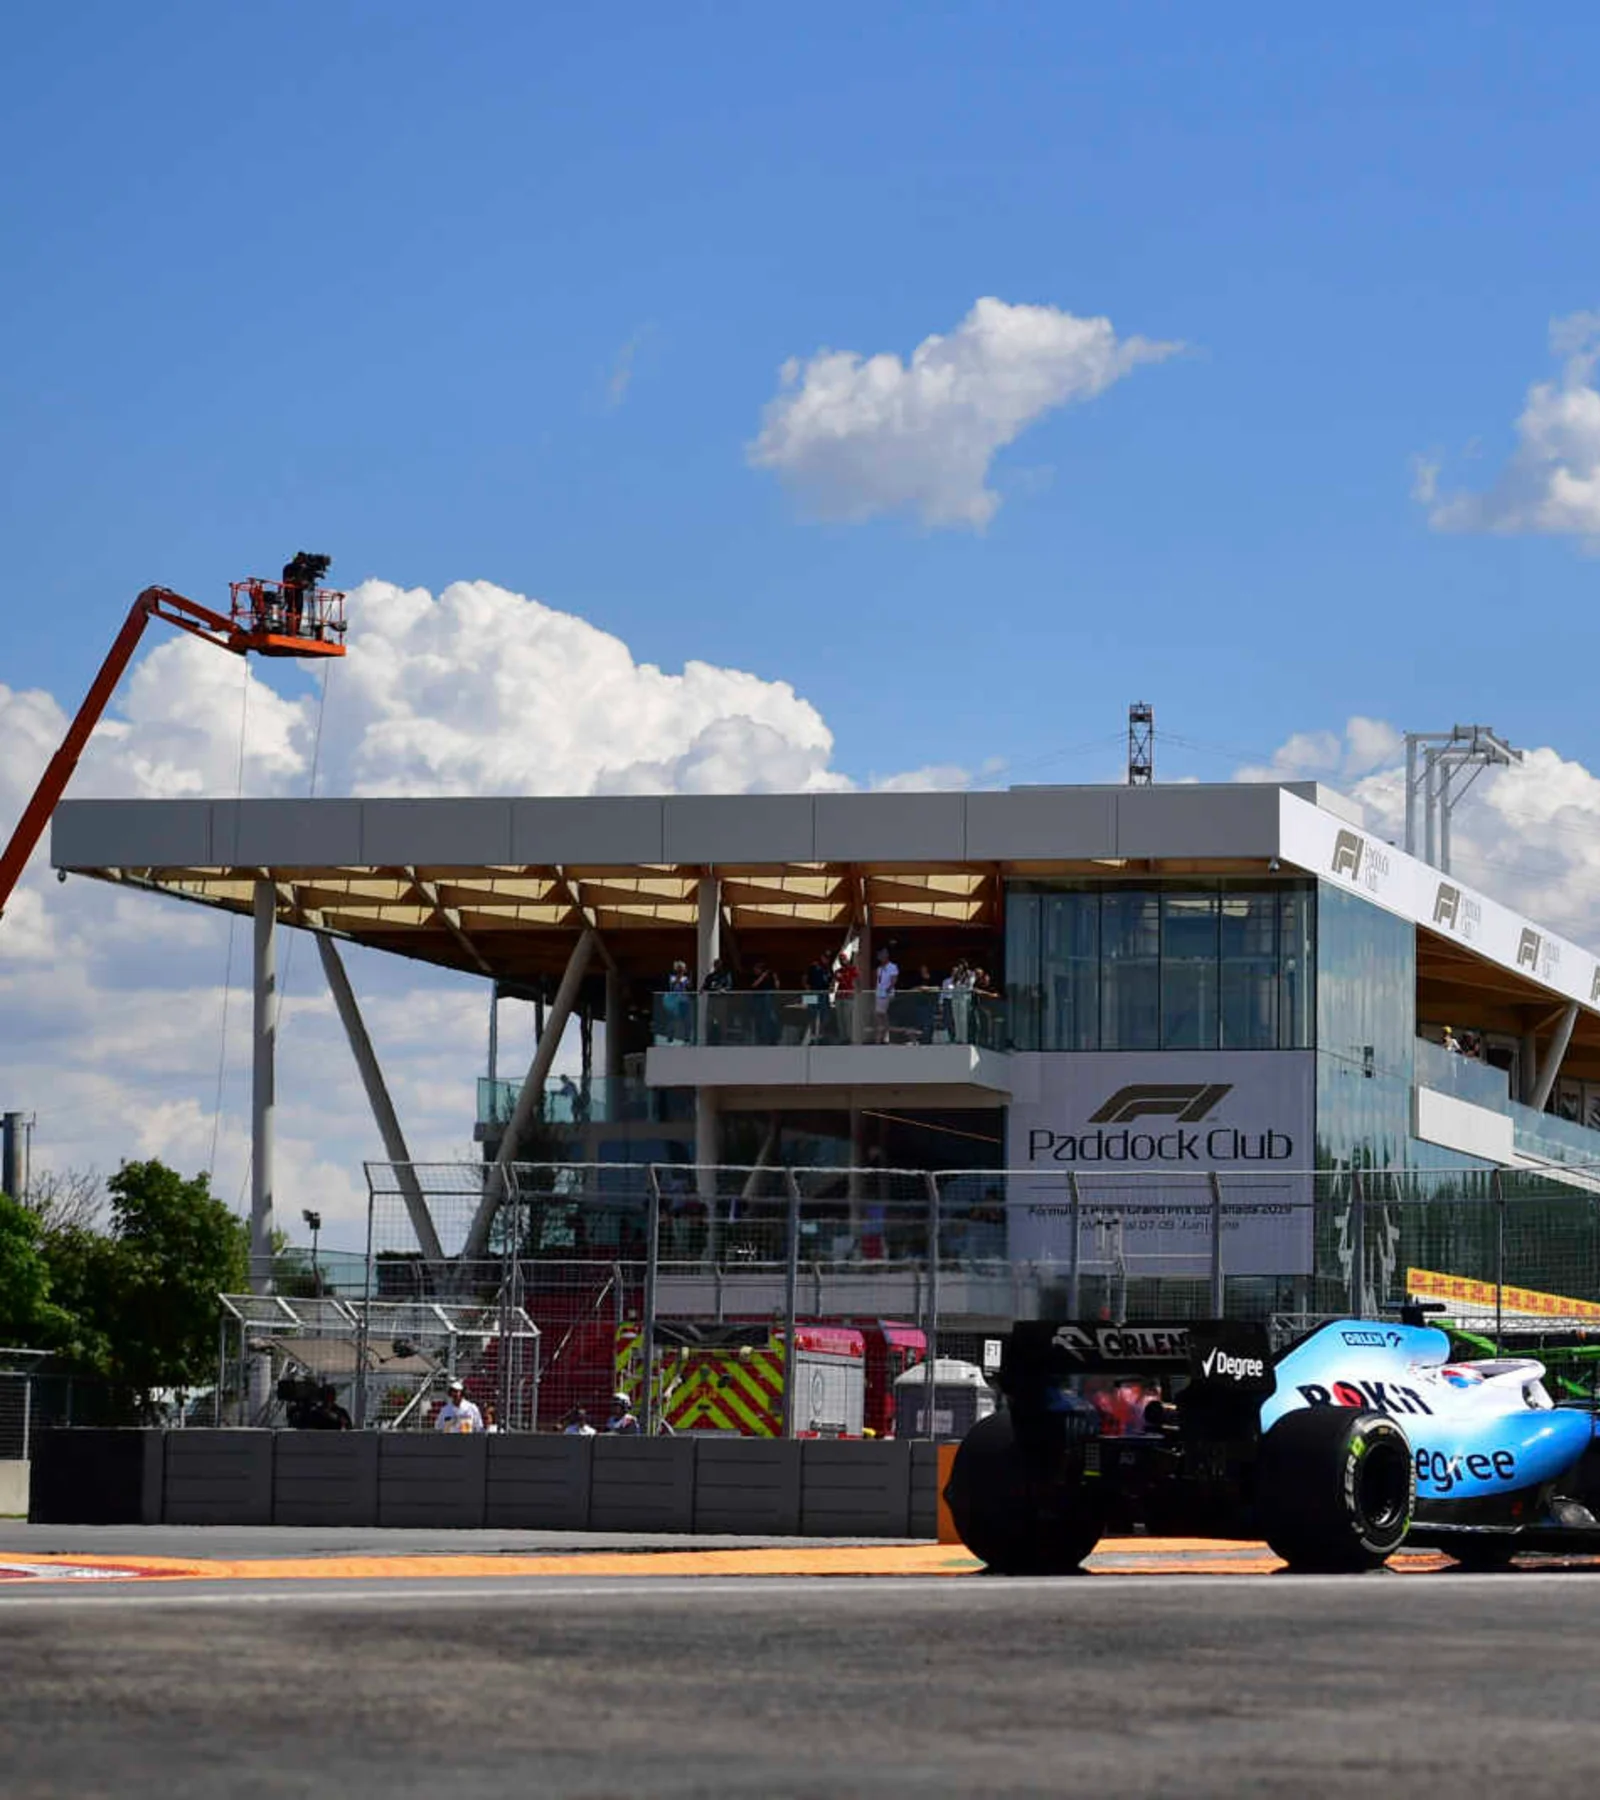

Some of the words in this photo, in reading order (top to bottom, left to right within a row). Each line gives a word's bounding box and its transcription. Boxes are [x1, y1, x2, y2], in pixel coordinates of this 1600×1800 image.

[1088, 1084, 1233, 1123] F1
[1029, 1129, 1200, 1161] Paddock
[1207, 1129, 1292, 1161] Club
[1028, 1204, 1073, 1216] Formul
[1102, 1331, 1188, 1358] ORLEN
[1345, 1332, 1383, 1346] ORLEN
[1216, 1352, 1264, 1381] Degree
[1415, 1447, 1515, 1493] egree
